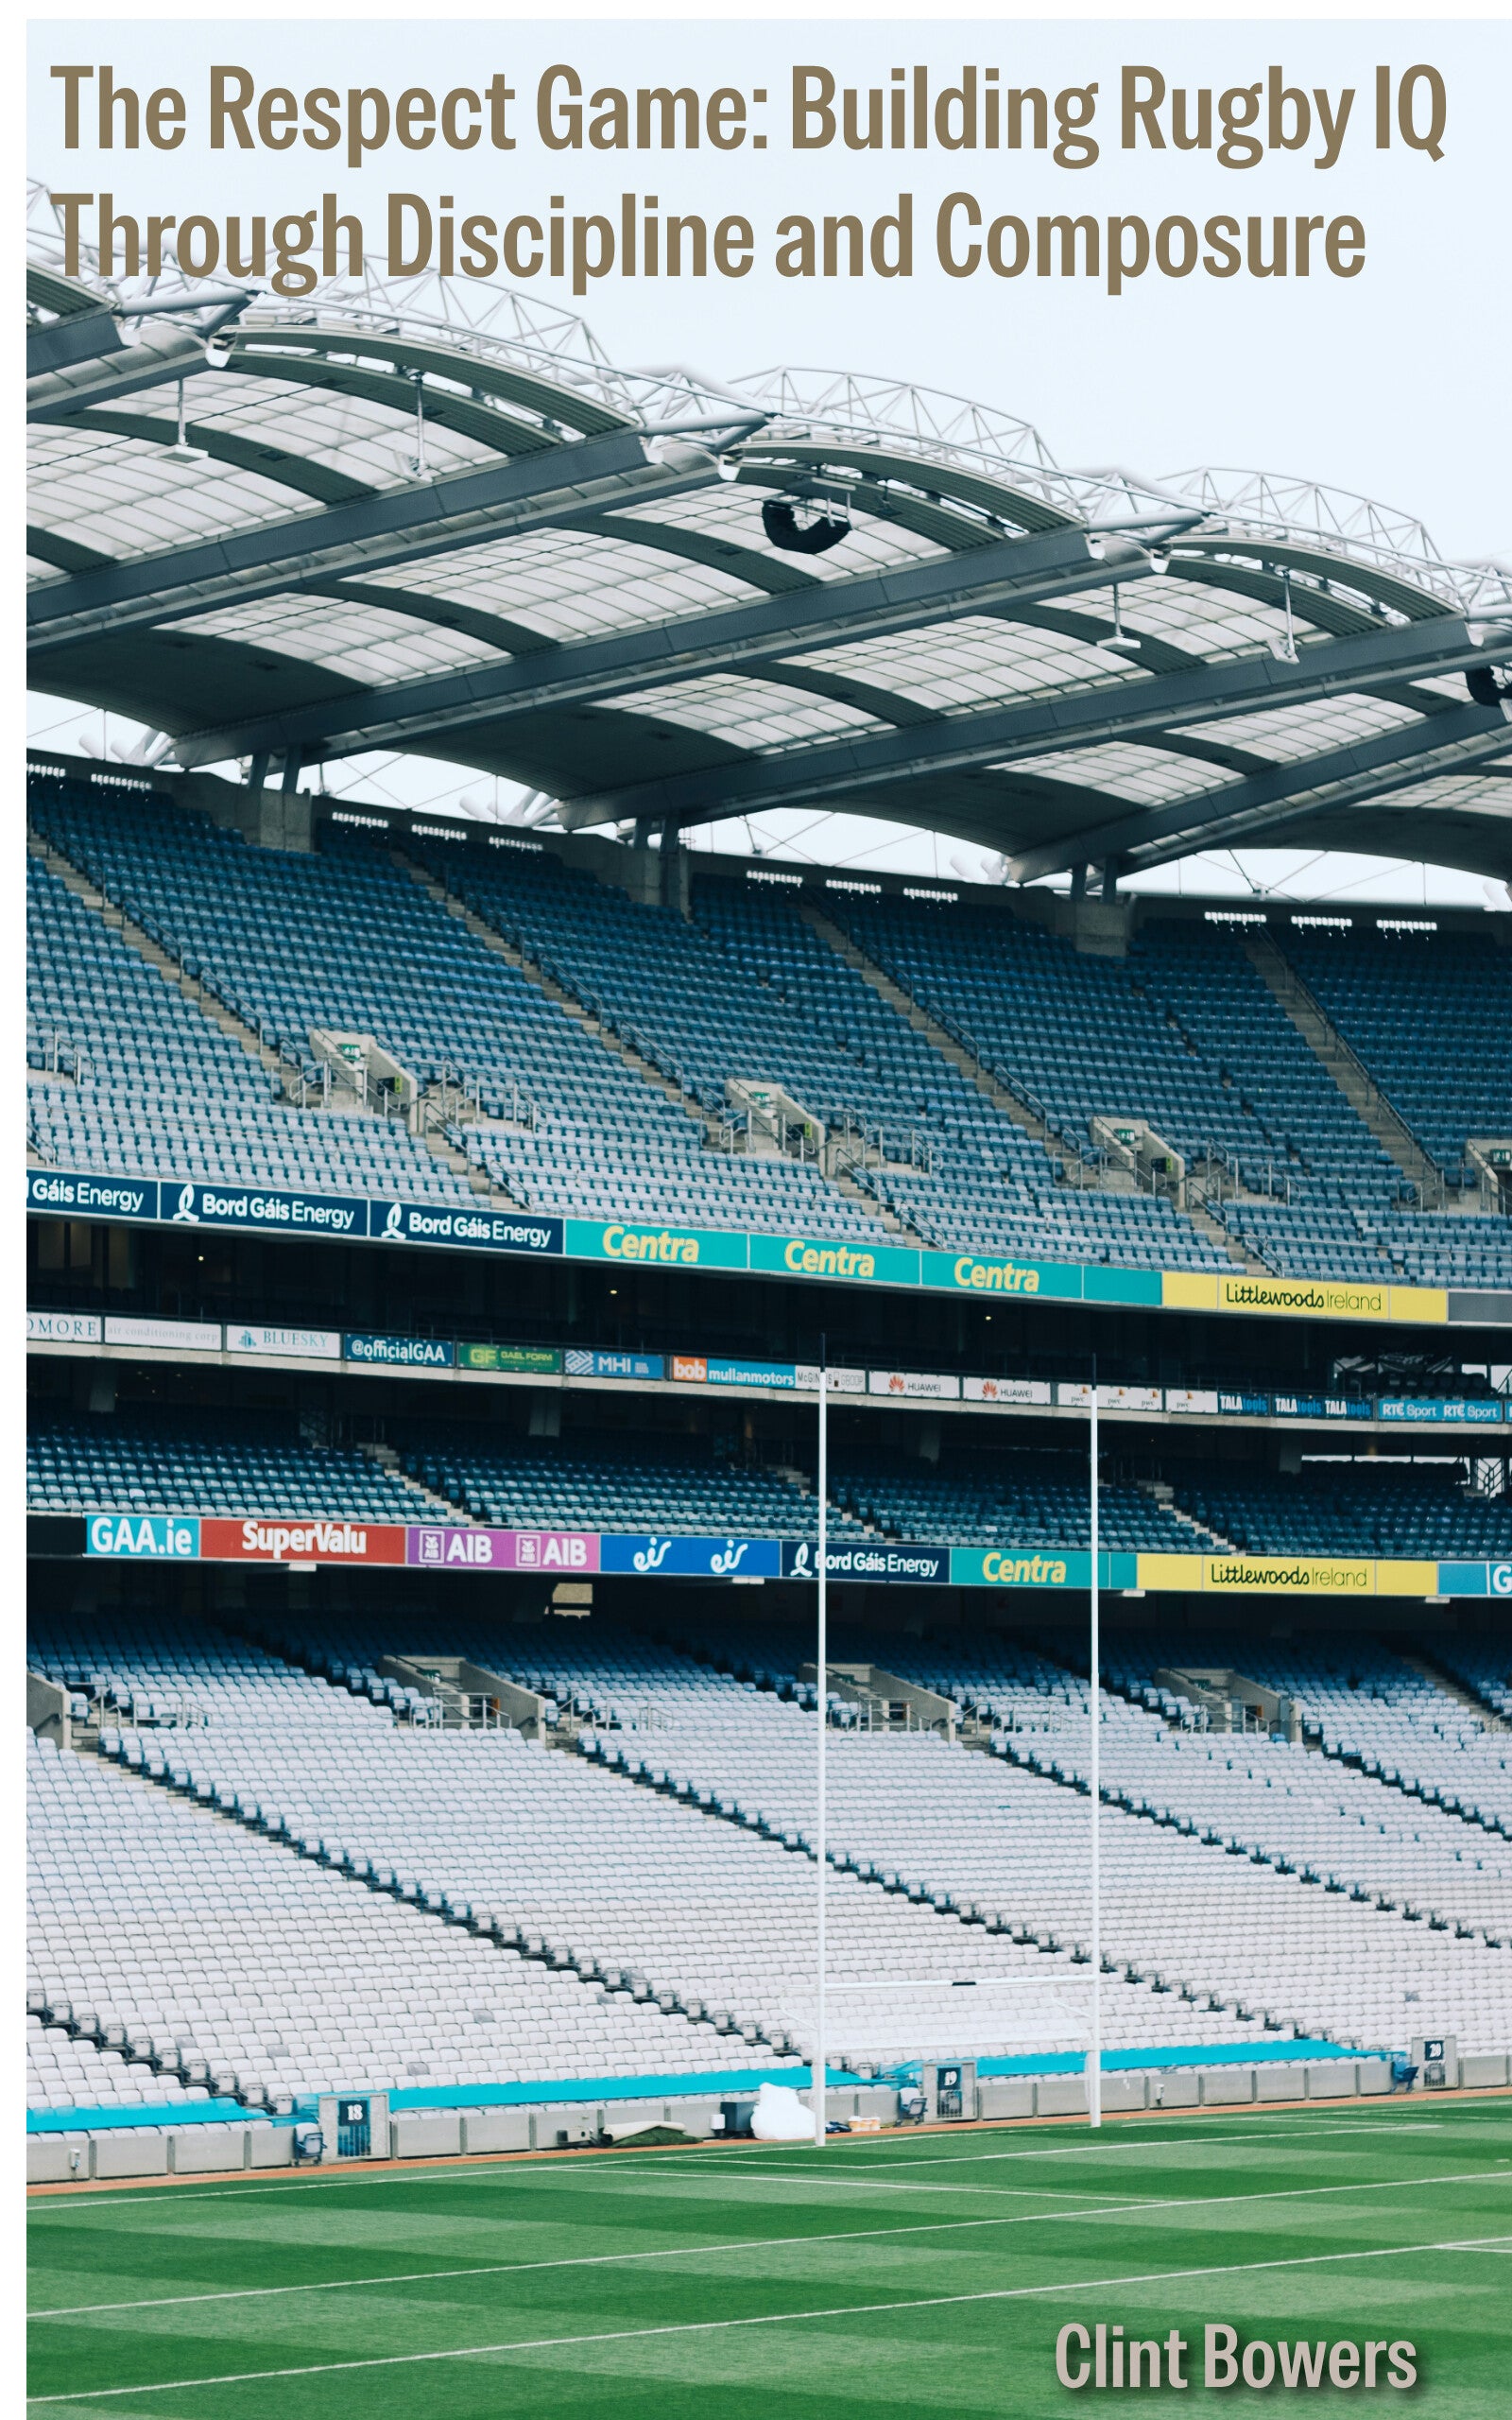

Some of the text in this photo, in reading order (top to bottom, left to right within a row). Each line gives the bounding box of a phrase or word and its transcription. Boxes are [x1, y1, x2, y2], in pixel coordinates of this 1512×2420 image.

[32, 1178, 74, 1203] Gáis
[77, 1183, 144, 1213] Energy
[202, 1193, 354, 1230] Bord Gáis Energy
[409, 1212, 551, 1248] Bord Gáis Energy
[602, 1225, 699, 1263] Centra
[784, 1240, 875, 1278] Centra
[954, 1256, 1040, 1293] Centra
[352, 1339, 446, 1362] @officialGAA
[470, 1348, 497, 1364] GF
[597, 1356, 631, 1374] MHI
[673, 1358, 706, 1381] bob
[708, 1367, 795, 1387] mullanmotors
[907, 1383, 942, 1392] HUAWEI
[1000, 1389, 1033, 1399] HUAWEI
[1407, 1405, 1436, 1419] Sport
[1468, 1405, 1497, 1420] Sport
[91, 1517, 192, 1555] GAA.ie
[242, 1520, 367, 1559] SuperValu
[446, 1532, 493, 1564] AIB
[542, 1537, 588, 1566] AIB
[633, 1536, 748, 1574] eir eir
[853, 1551, 886, 1572] Gáis
[887, 1554, 938, 1578] Energy
[983, 1552, 1066, 1583] Centra
[347, 2103, 363, 2120] 18
